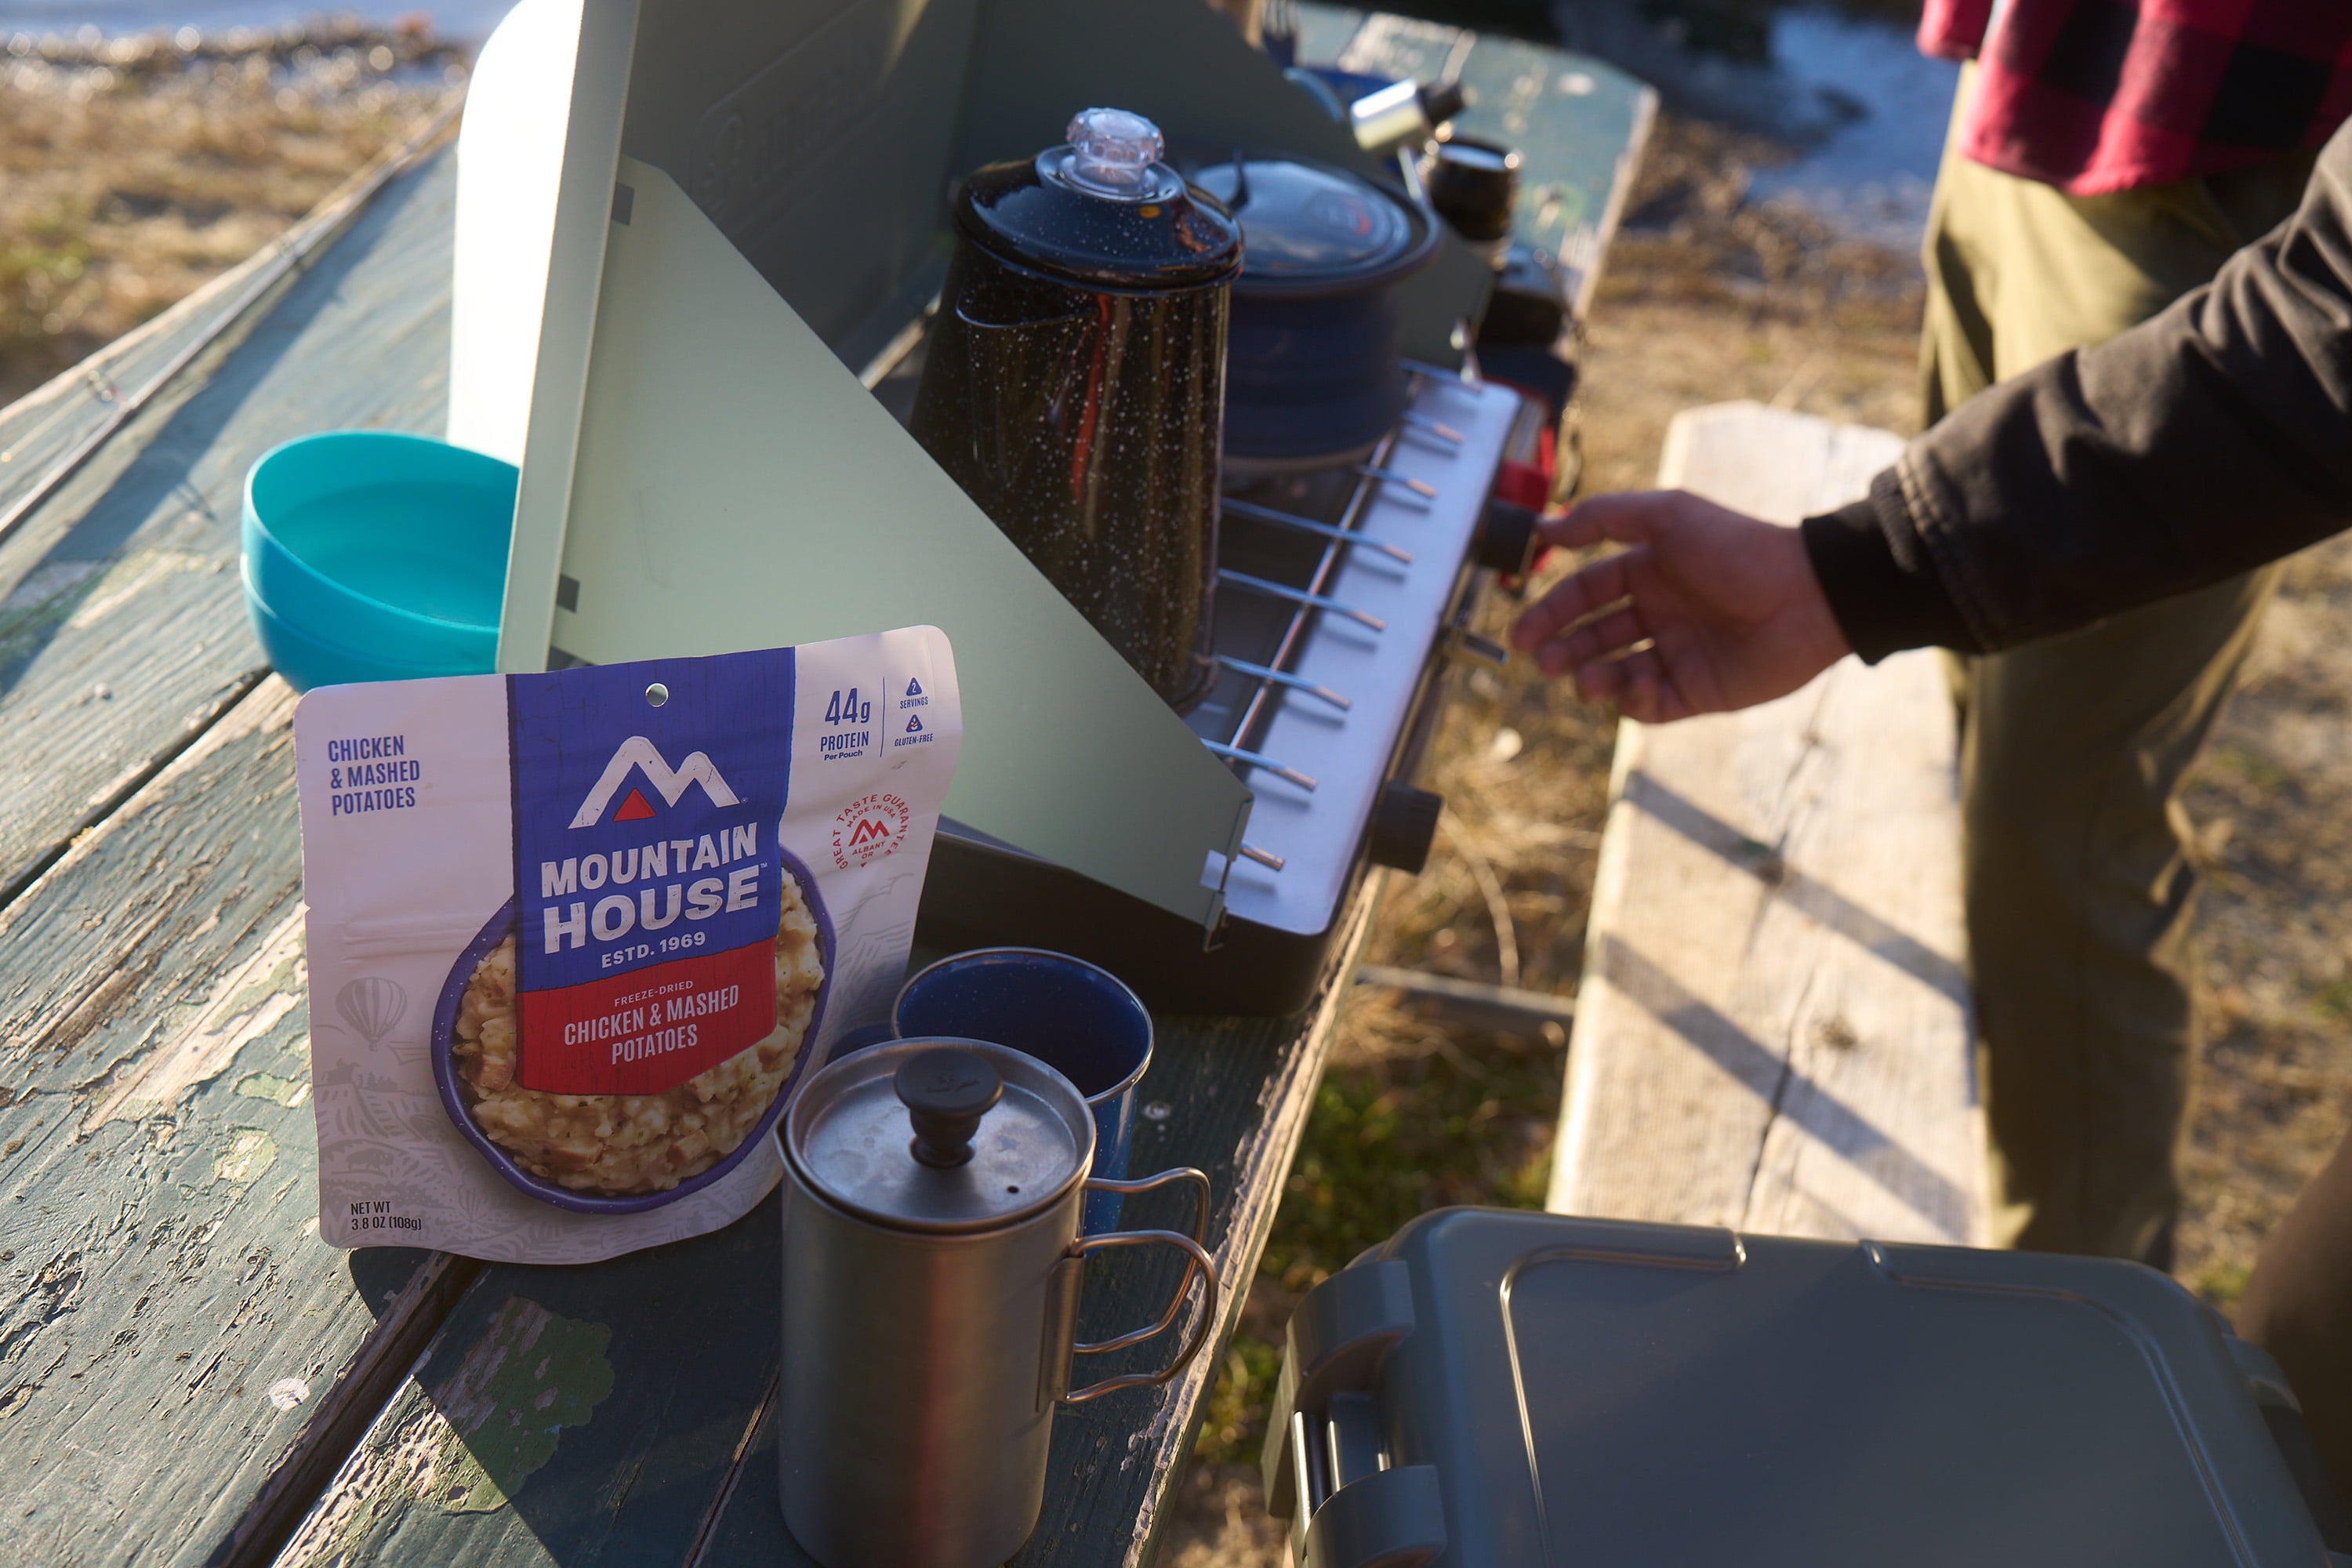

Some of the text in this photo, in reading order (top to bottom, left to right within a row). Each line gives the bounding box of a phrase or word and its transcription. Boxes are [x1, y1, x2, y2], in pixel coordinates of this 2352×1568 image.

[911, 682, 916, 693] 2
[825, 688, 871, 726] 44g
[900, 696, 928, 709] SERVINGS
[328, 735, 404, 762] CHICKEN
[820, 731, 869, 752] PROTEIN
[895, 733, 934, 746] GLUTEN-FREE
[838, 750, 862, 759] Pouch
[331, 760, 420, 789] & MASHED
[332, 786, 416, 815] POTATOES
[847, 806, 870, 828] MADE
[884, 806, 896, 818] USA
[833, 793, 909, 869] GREAT TASTE GUARANTEE
[541, 822, 758, 898] MOUNTAIN
[852, 840, 885, 855] ALBANY
[543, 865, 760, 954] HOUSE
[601, 931, 706, 968] ESTD. 1969
[615, 980, 694, 1007] FREEZE-DRIED
[564, 985, 739, 1046] CHICKEN & MASHED
[612, 1024, 698, 1065] POTATOES
[351, 1201, 390, 1215] NET WT
[351, 1216, 422, 1230] 3.8 OZ (108g)
